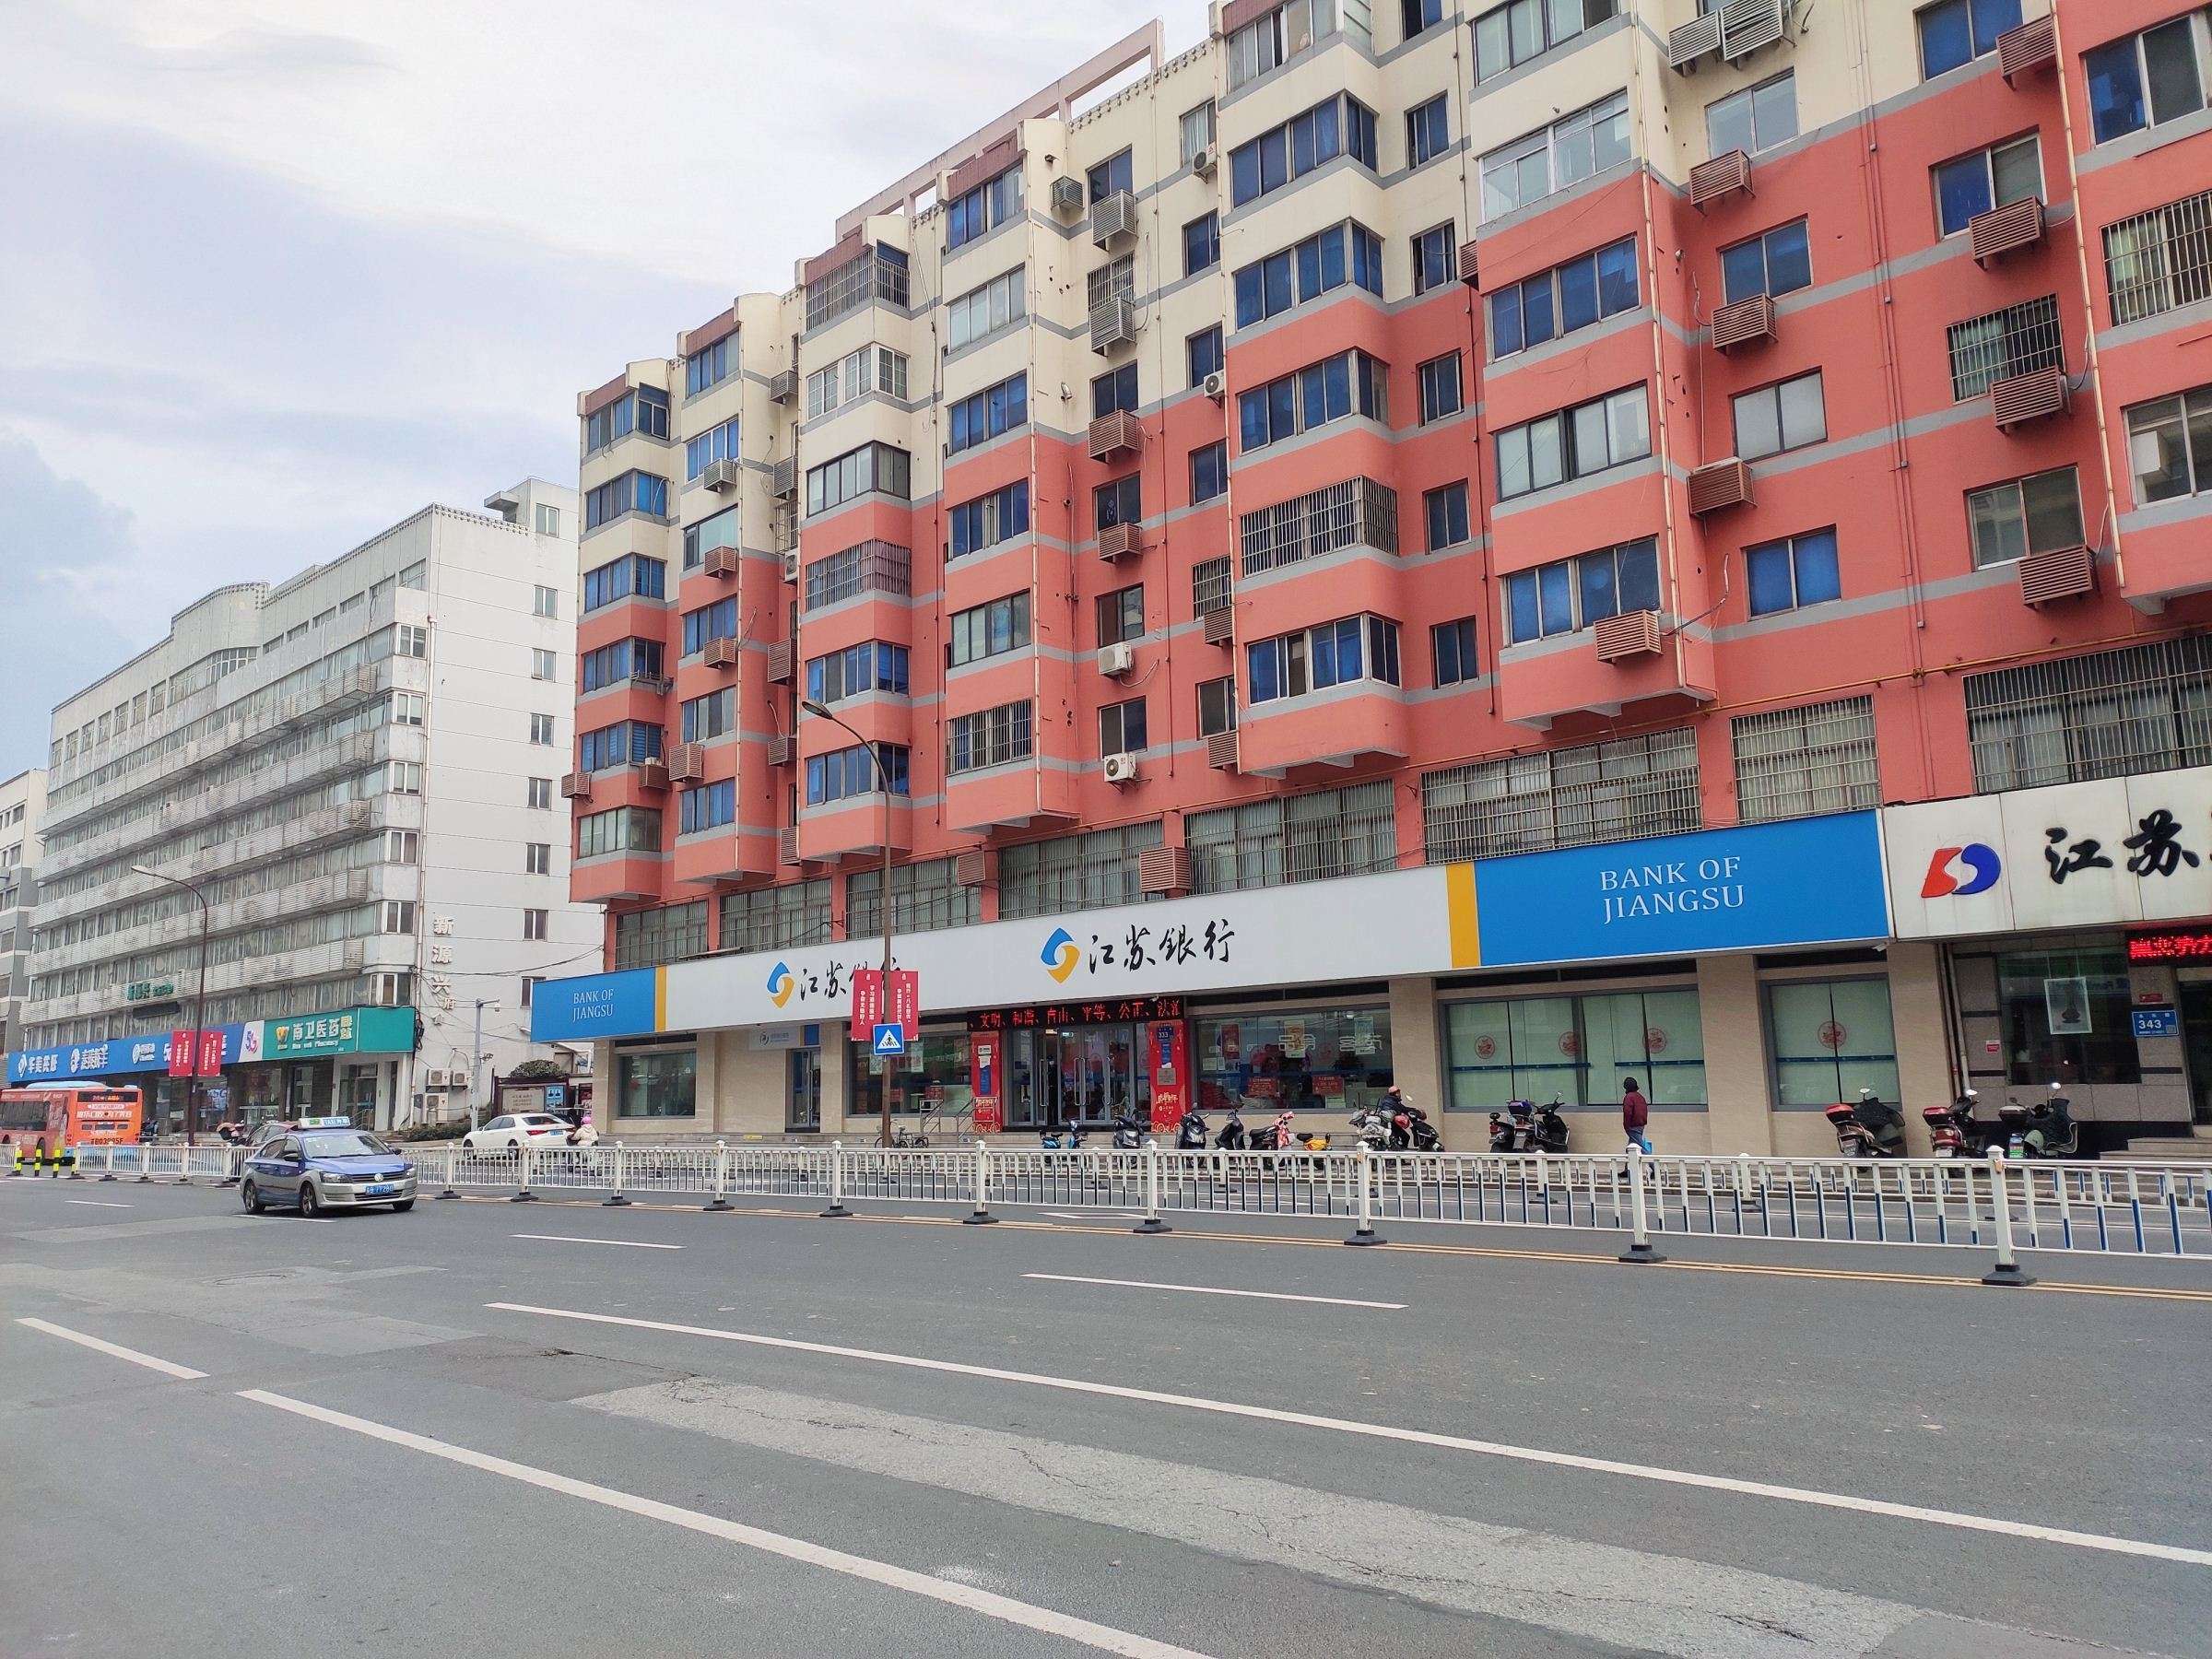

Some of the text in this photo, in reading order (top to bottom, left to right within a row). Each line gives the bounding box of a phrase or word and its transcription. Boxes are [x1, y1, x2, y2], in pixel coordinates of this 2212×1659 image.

[2045, 809, 2212, 884] 江苏
[1600, 856, 1741, 891] BANK OF
[1603, 885, 1744, 924] JIANGSU
[1089, 918, 1235, 974] 江苏银行
[573, 988, 614, 1004] BANK OF
[800, 957, 901, 1001] 江苏
[573, 1004, 614, 1023] JIANGSU
[2138, 1019, 2162, 1030] 343
